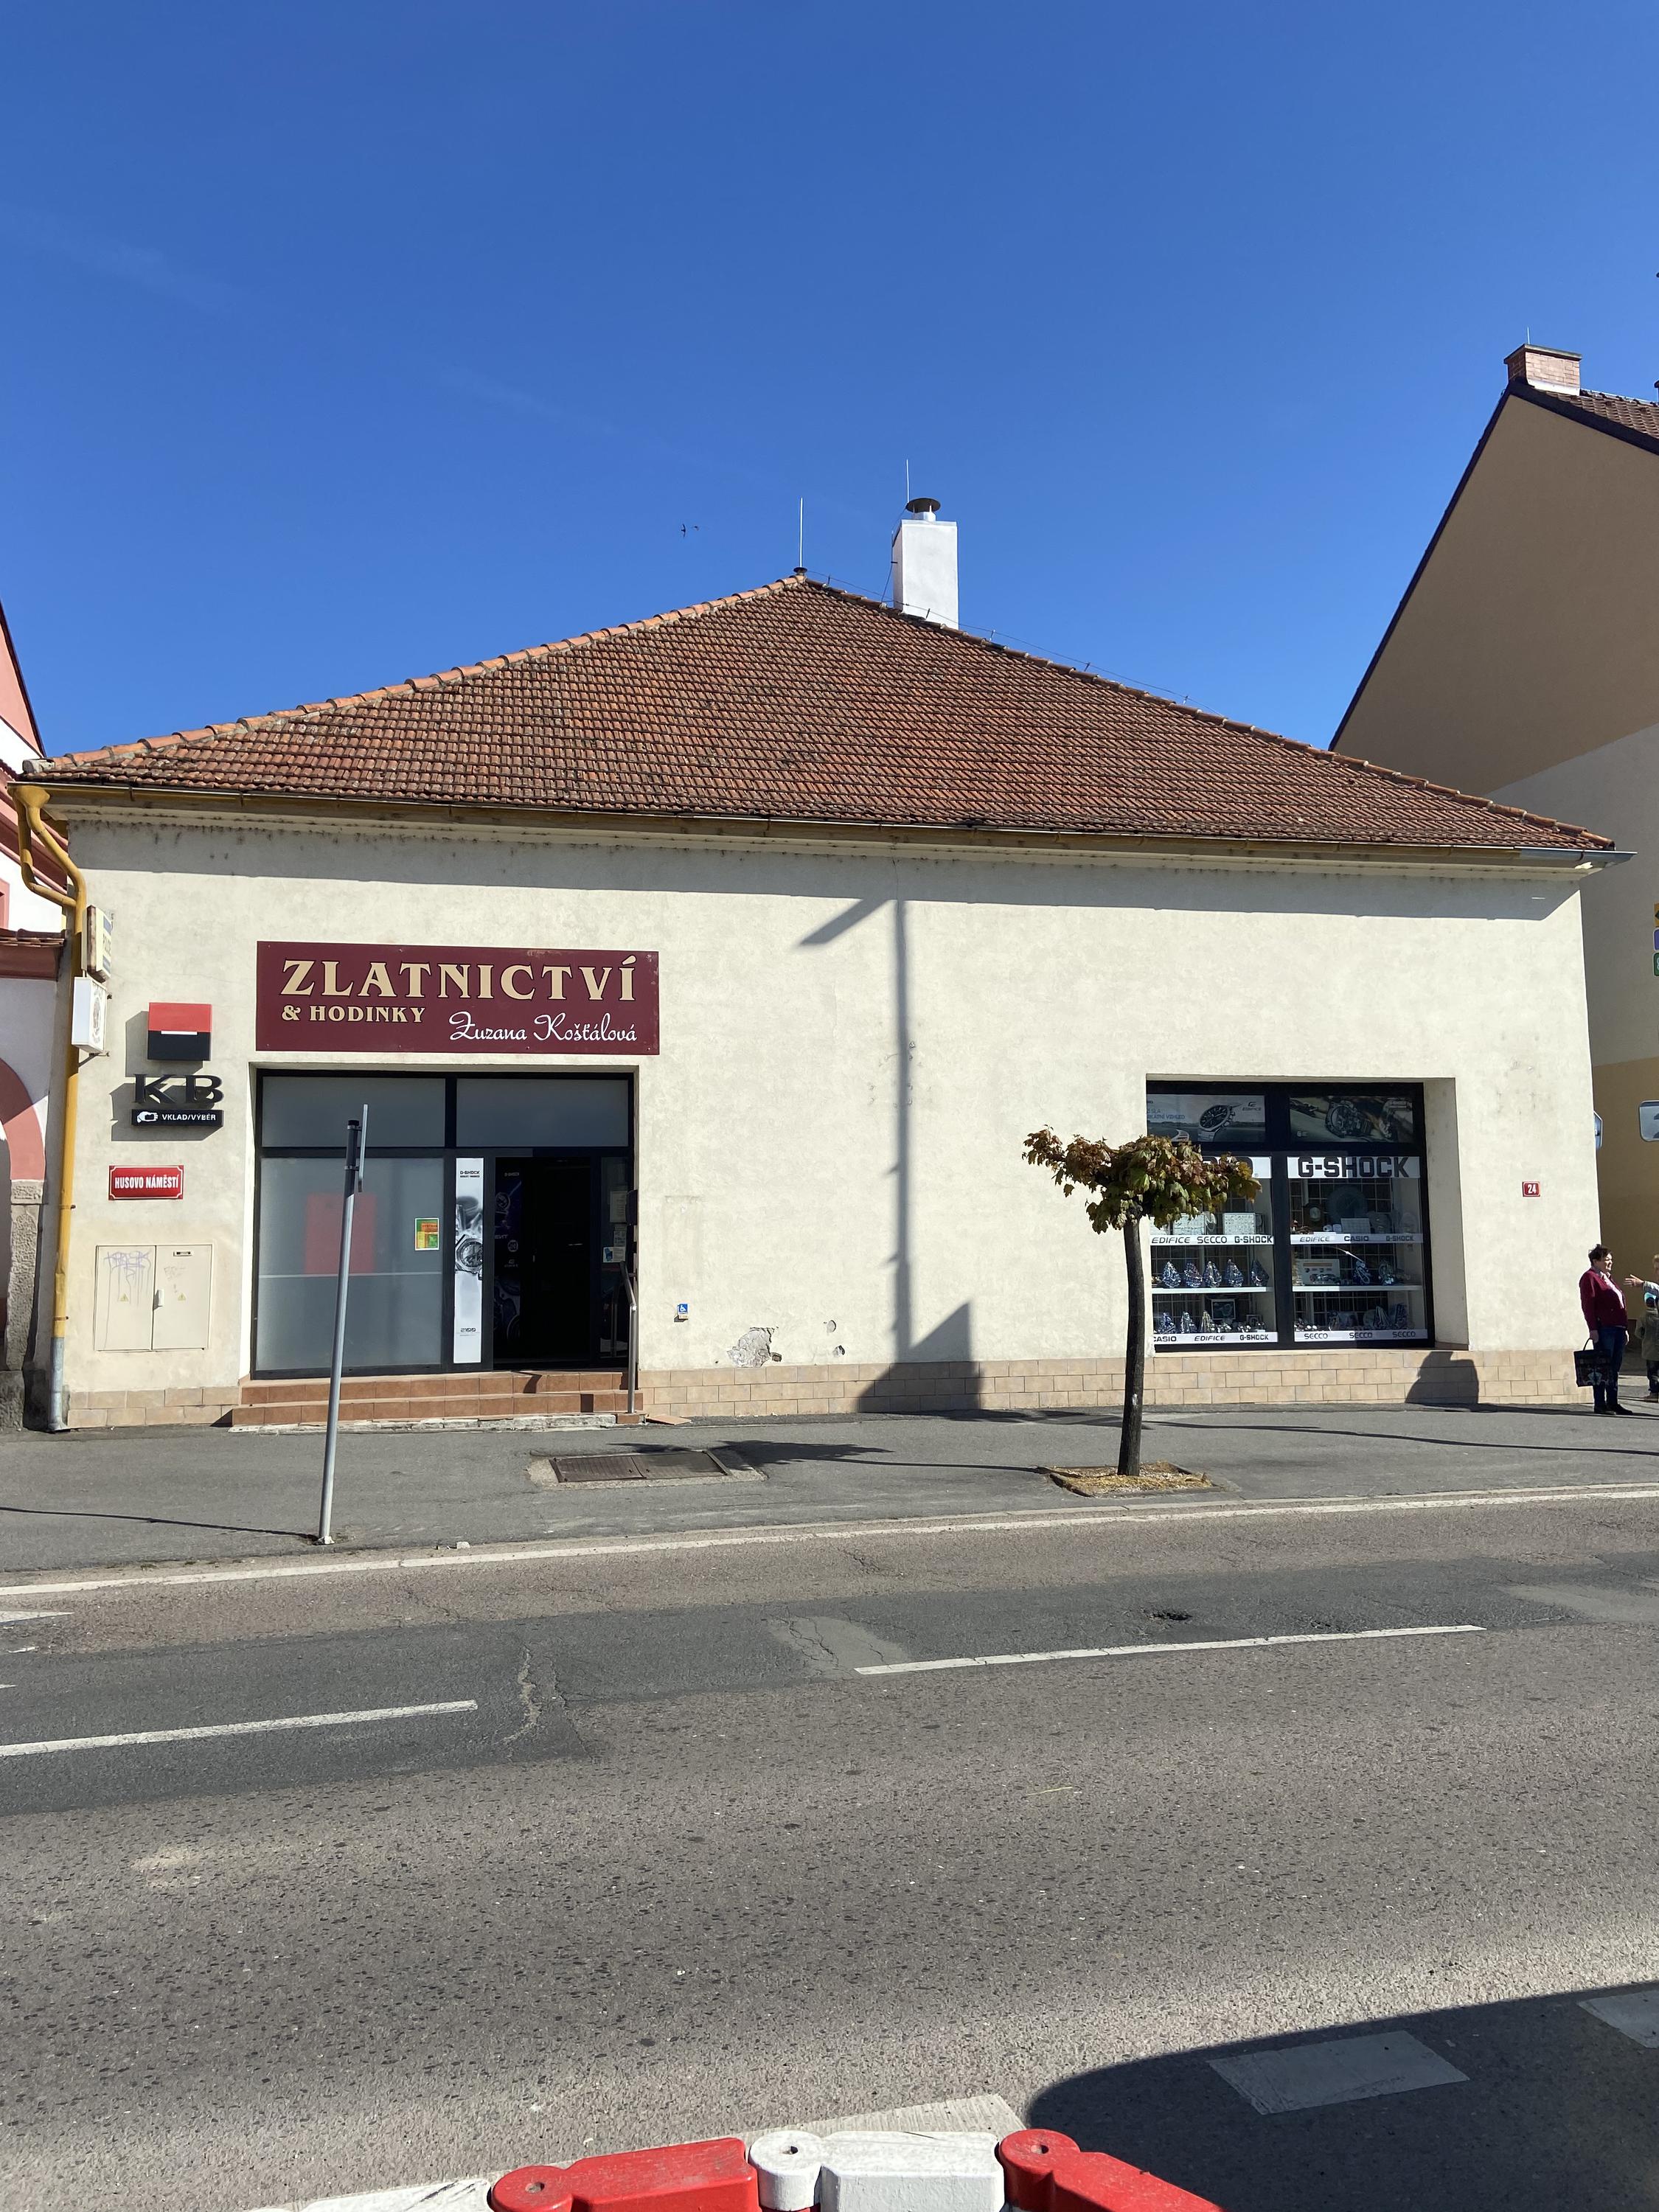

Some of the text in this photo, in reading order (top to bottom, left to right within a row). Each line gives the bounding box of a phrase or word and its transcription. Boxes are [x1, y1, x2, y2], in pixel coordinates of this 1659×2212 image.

[279, 955, 637, 1001] ZLATNICTVÍ
[281, 1005, 425, 1023] & HODINKY
[448, 1011, 638, 1042] Zuzana Košťálová
[132, 1074, 224, 1104] KB
[161, 1113, 216, 1121] VKLAD/VÝBĚR
[1298, 1156, 1409, 1178] G-SHOCK
[114, 1174, 179, 1189] HUSOVO NÁMĚSTÍ
[1528, 1183, 1537, 1194] 24
[1197, 1236, 1228, 1244] SECCO
